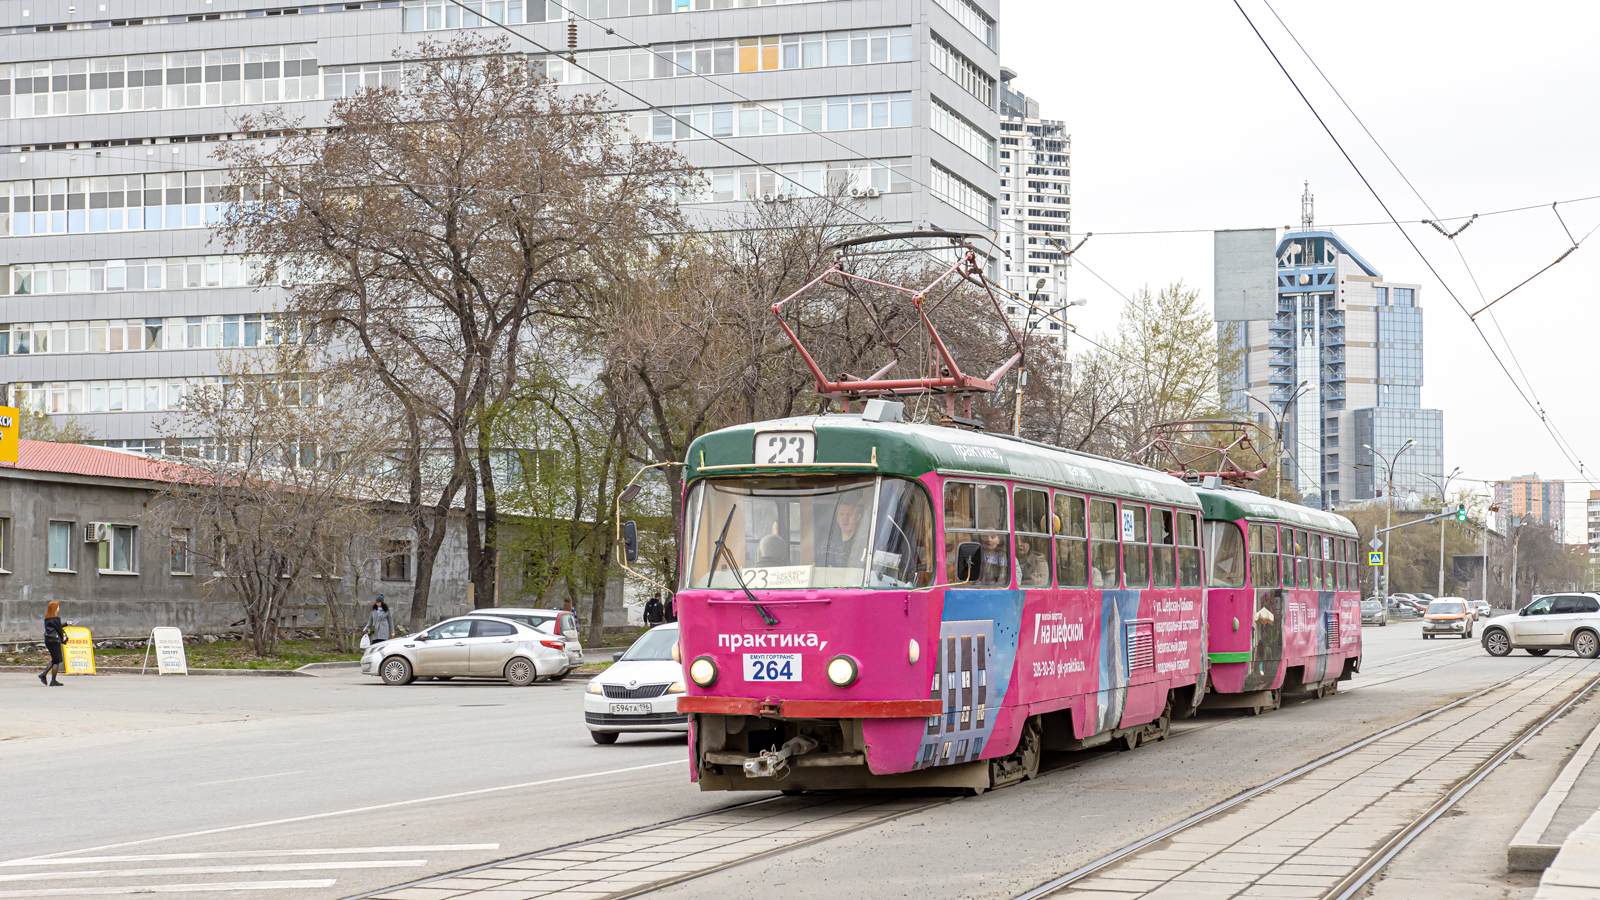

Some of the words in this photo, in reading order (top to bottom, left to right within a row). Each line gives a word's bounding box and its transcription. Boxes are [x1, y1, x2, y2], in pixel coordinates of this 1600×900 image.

[768, 437, 805, 464] 23
[1123, 513, 1133, 533] 264
[744, 569, 769, 588] 23
[752, 660, 793, 680] 264
[612, 704, 638, 712] Е594ТА
